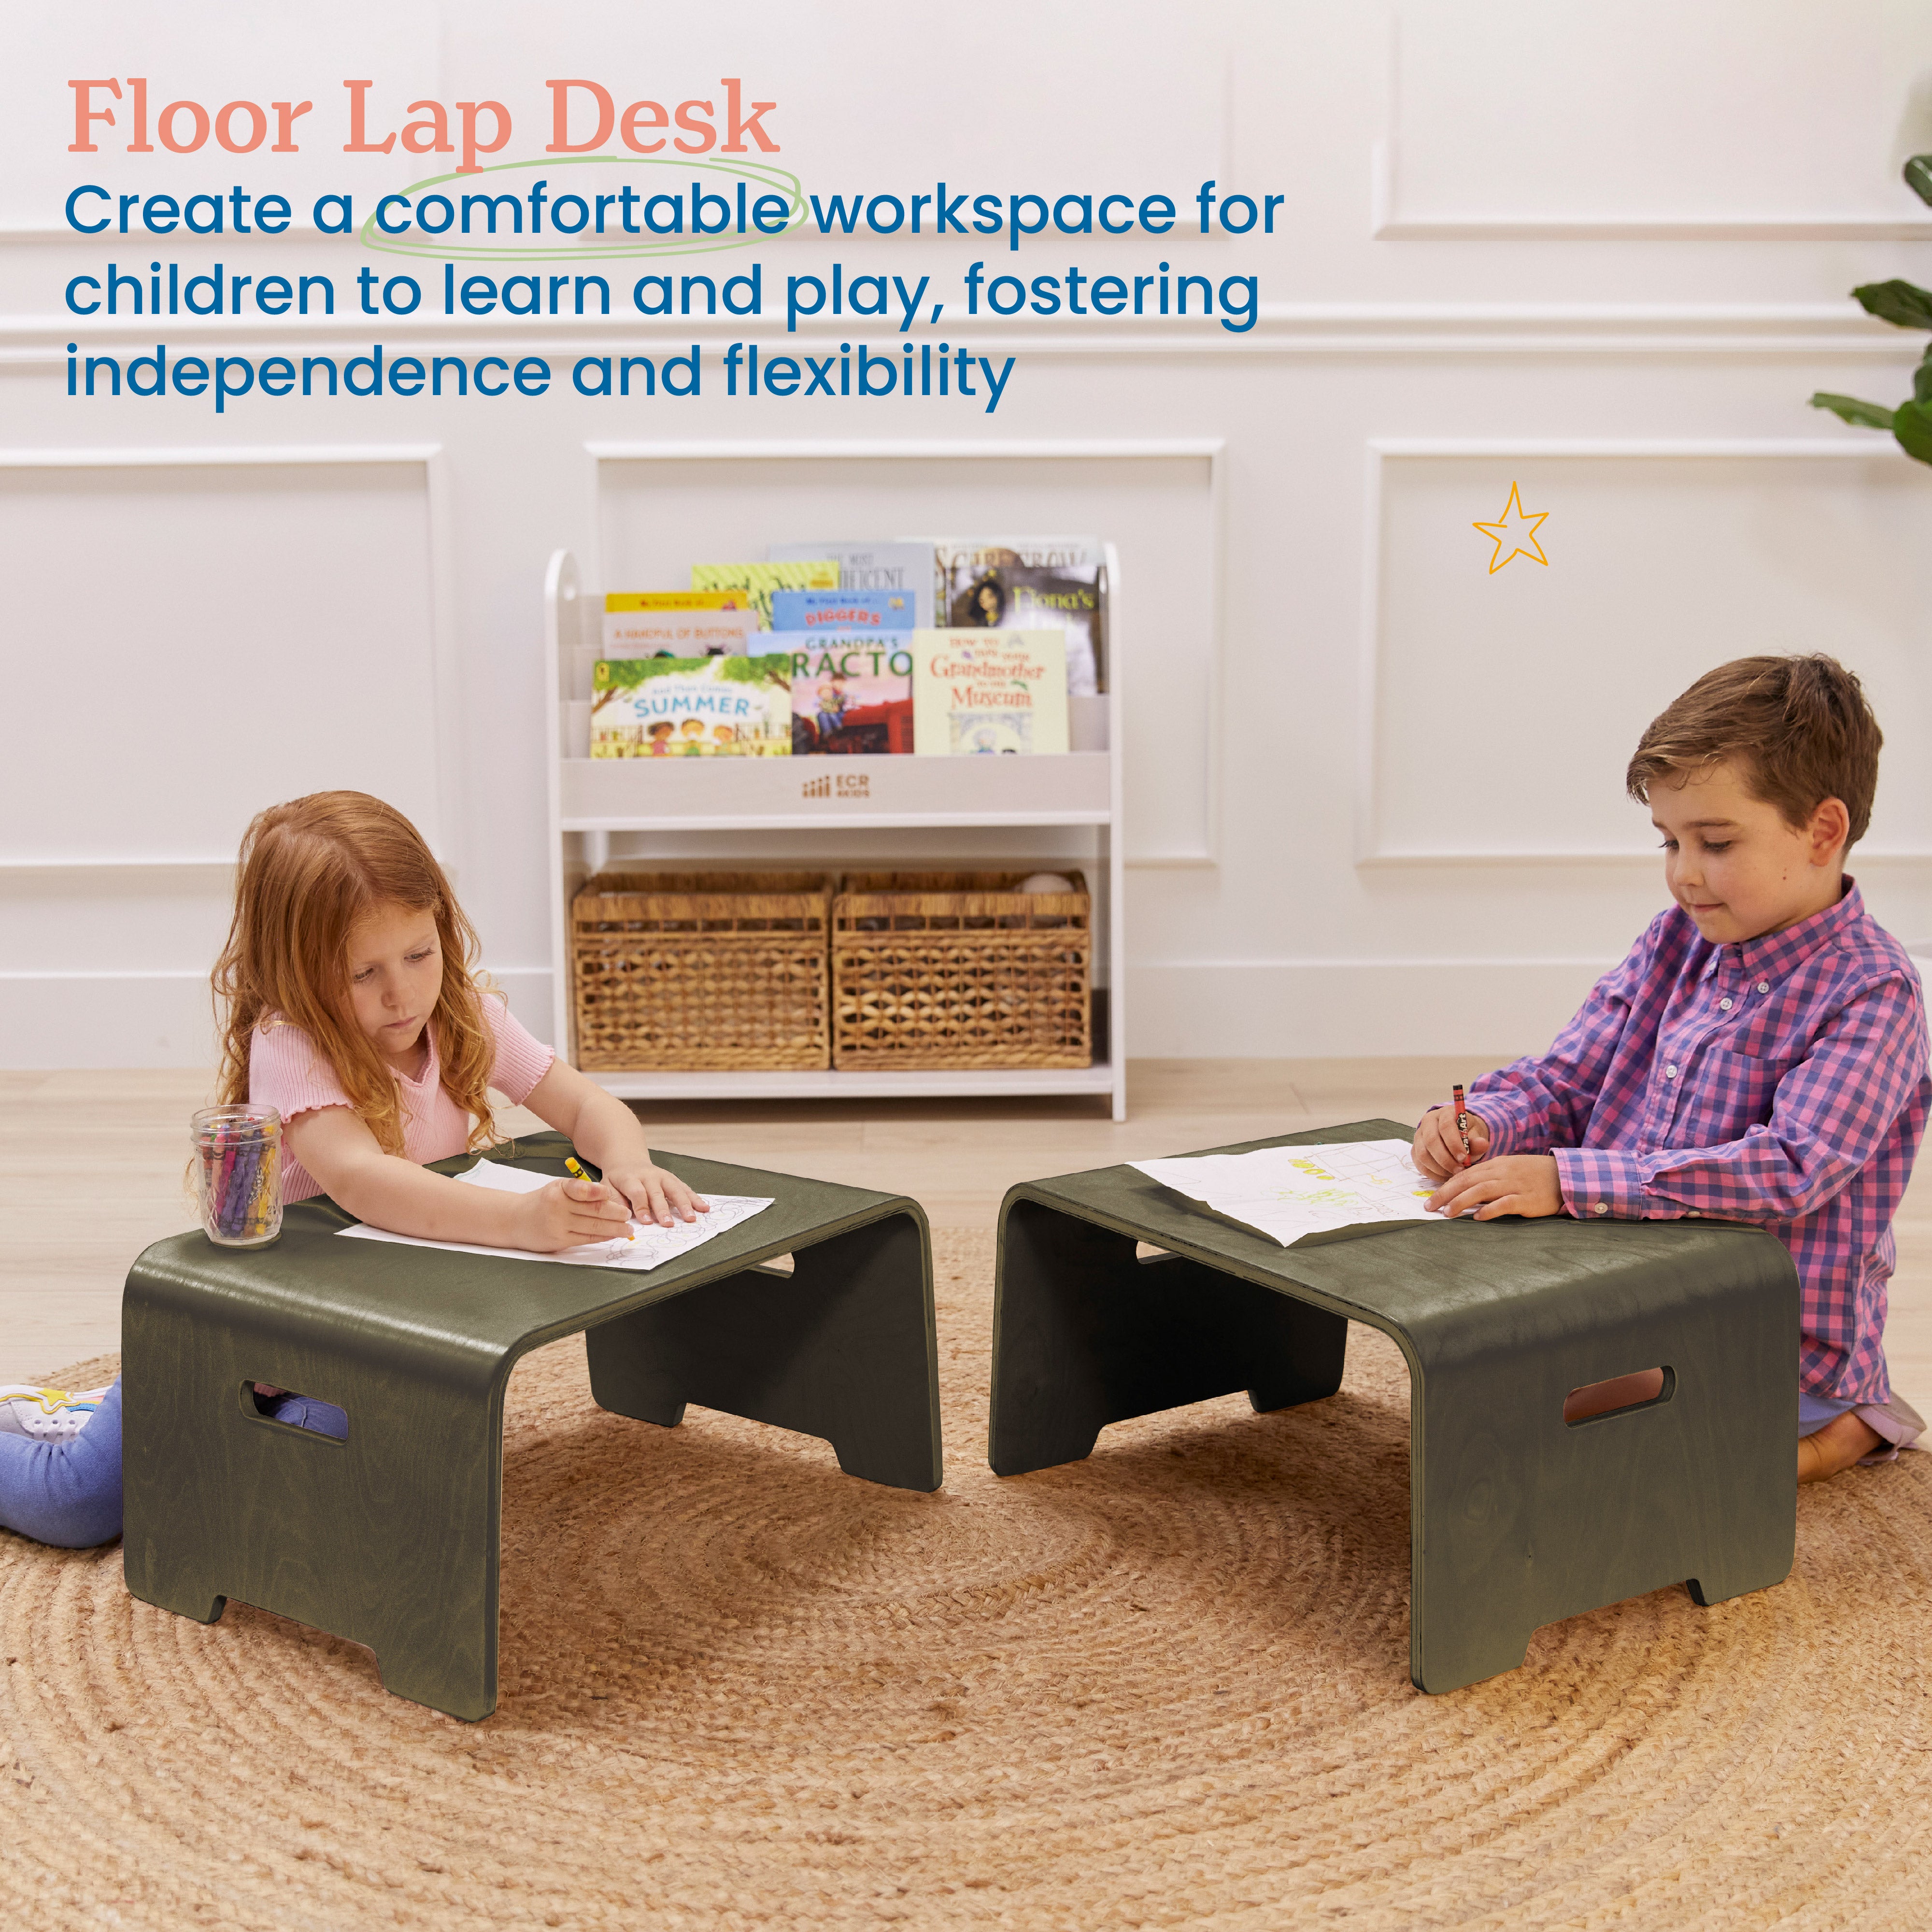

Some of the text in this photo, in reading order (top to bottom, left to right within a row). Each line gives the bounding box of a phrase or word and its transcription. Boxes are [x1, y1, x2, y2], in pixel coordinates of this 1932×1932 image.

[805, 608, 882, 626] DIGGERS
[614, 629, 622, 639] A
[677, 629, 691, 639] OF
[694, 627, 743, 639] BUTTONS
[805, 637, 898, 650] GRANDPA'S
[792, 653, 913, 677] RACTO
[930, 653, 1046, 680] Grandmother
[634, 696, 750, 718] SUMMER
[951, 685, 1033, 710] Museum
[836, 774, 869, 787] ECR
